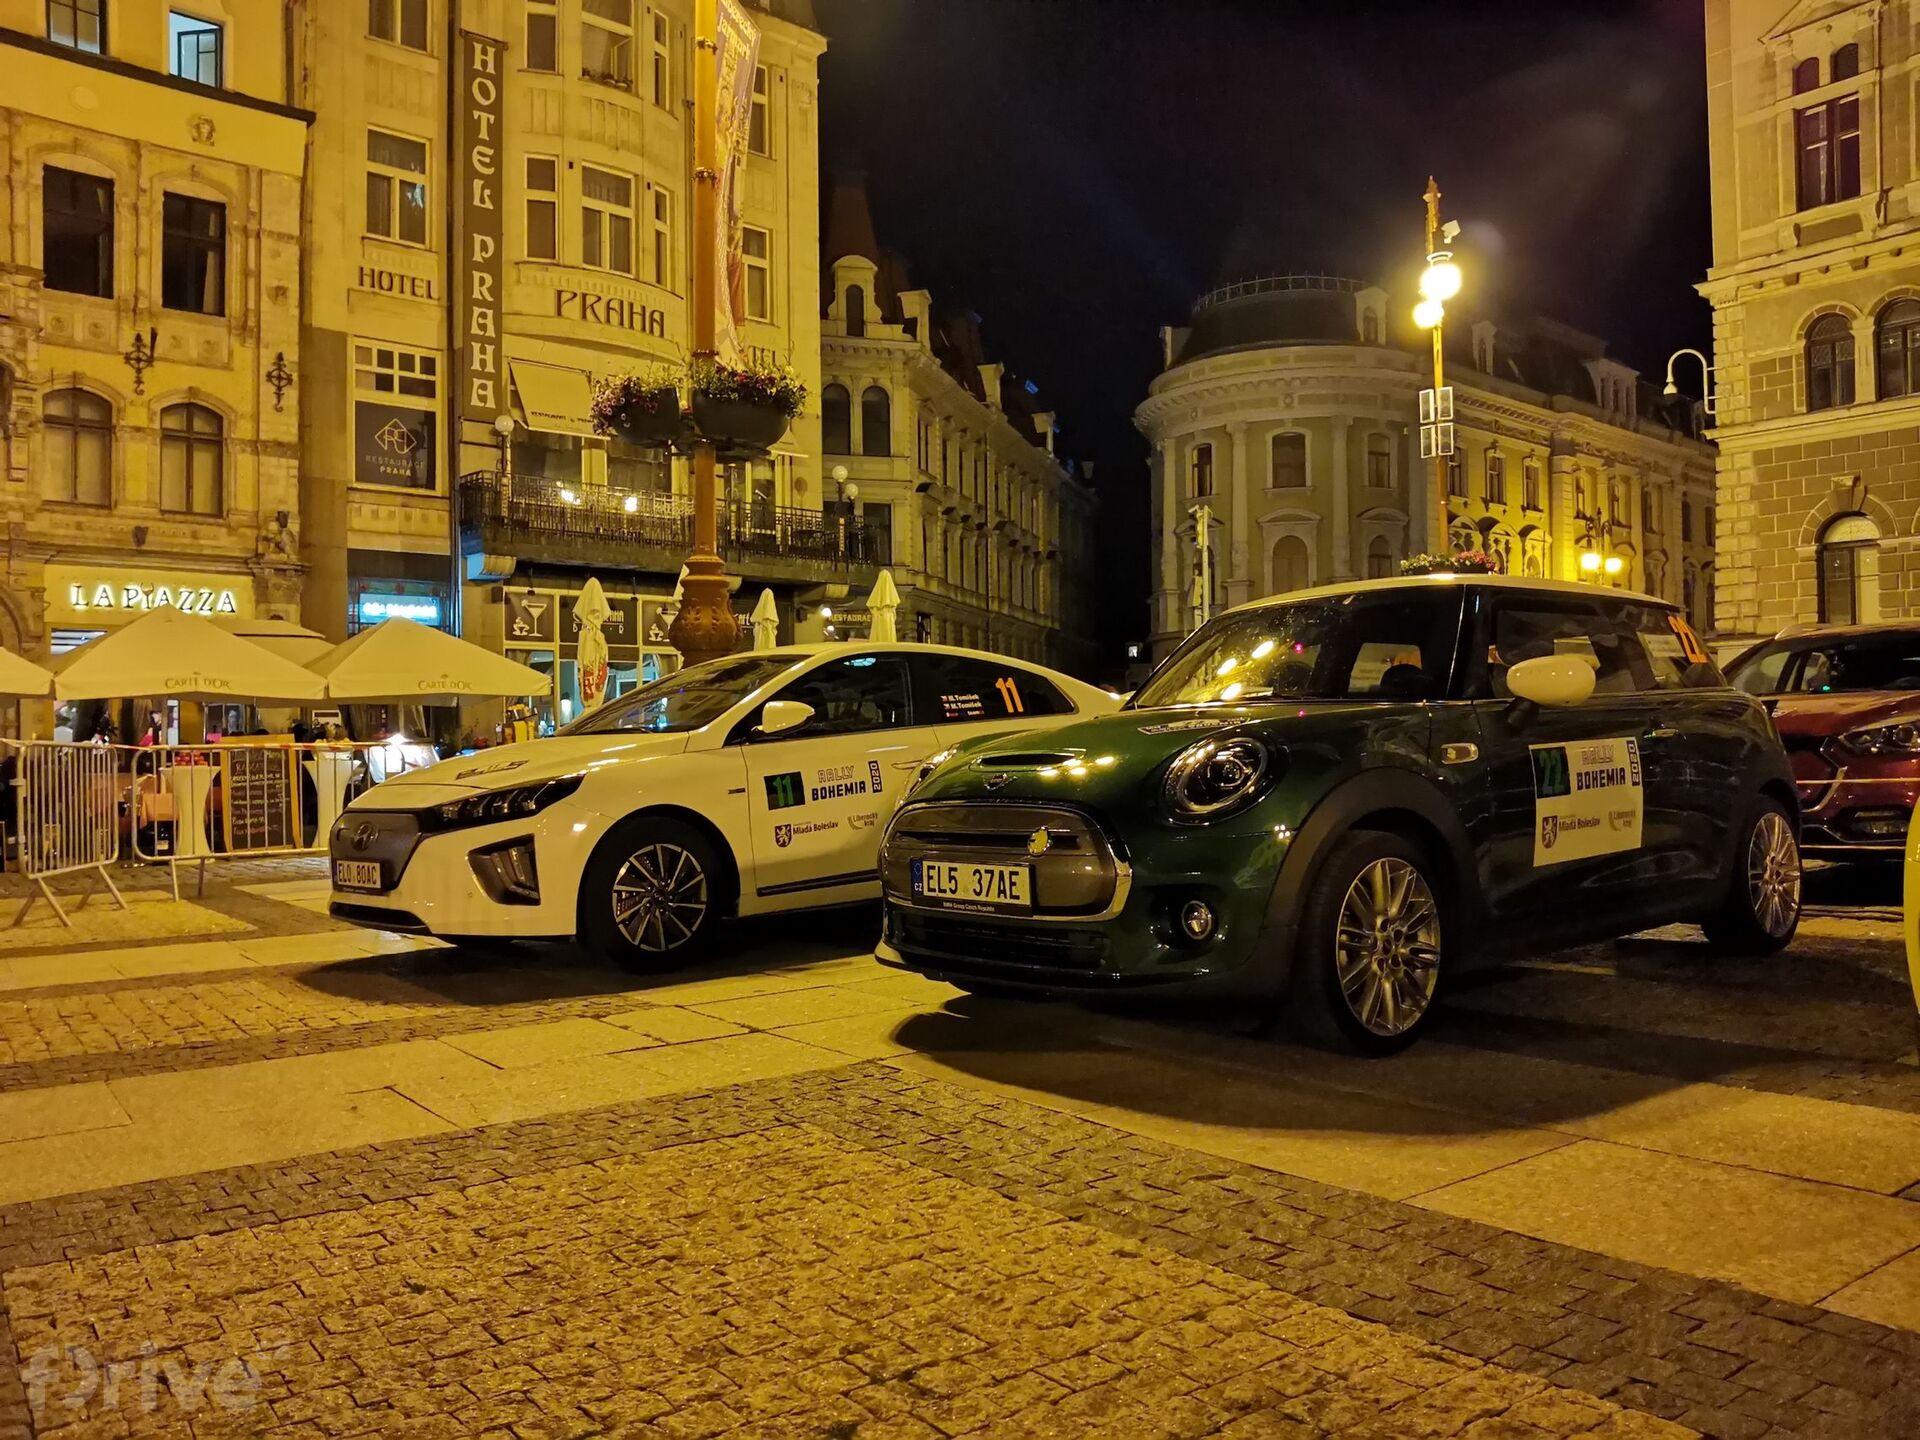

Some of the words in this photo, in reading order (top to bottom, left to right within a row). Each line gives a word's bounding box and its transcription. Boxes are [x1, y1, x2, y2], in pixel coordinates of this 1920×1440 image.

[472, 41, 496, 210] HOTEL
[358, 266, 440, 301] HOTEL
[470, 233, 496, 408] PRAHA
[556, 289, 664, 338] PRAHA
[380, 466, 411, 476] PRAHA
[72, 584, 114, 608] LA
[995, 677, 1024, 713] 11
[818, 765, 855, 783] RALLY
[869, 761, 882, 791] 2020
[1576, 767, 1626, 790] BOHEMIA
[772, 774, 795, 808] 11
[811, 780, 867, 801] BOHEMIA
[813, 821, 839, 832] Boleslav
[914, 882, 922, 891] CZ
[926, 864, 959, 894] EL5
[972, 868, 1021, 899] 37AE
